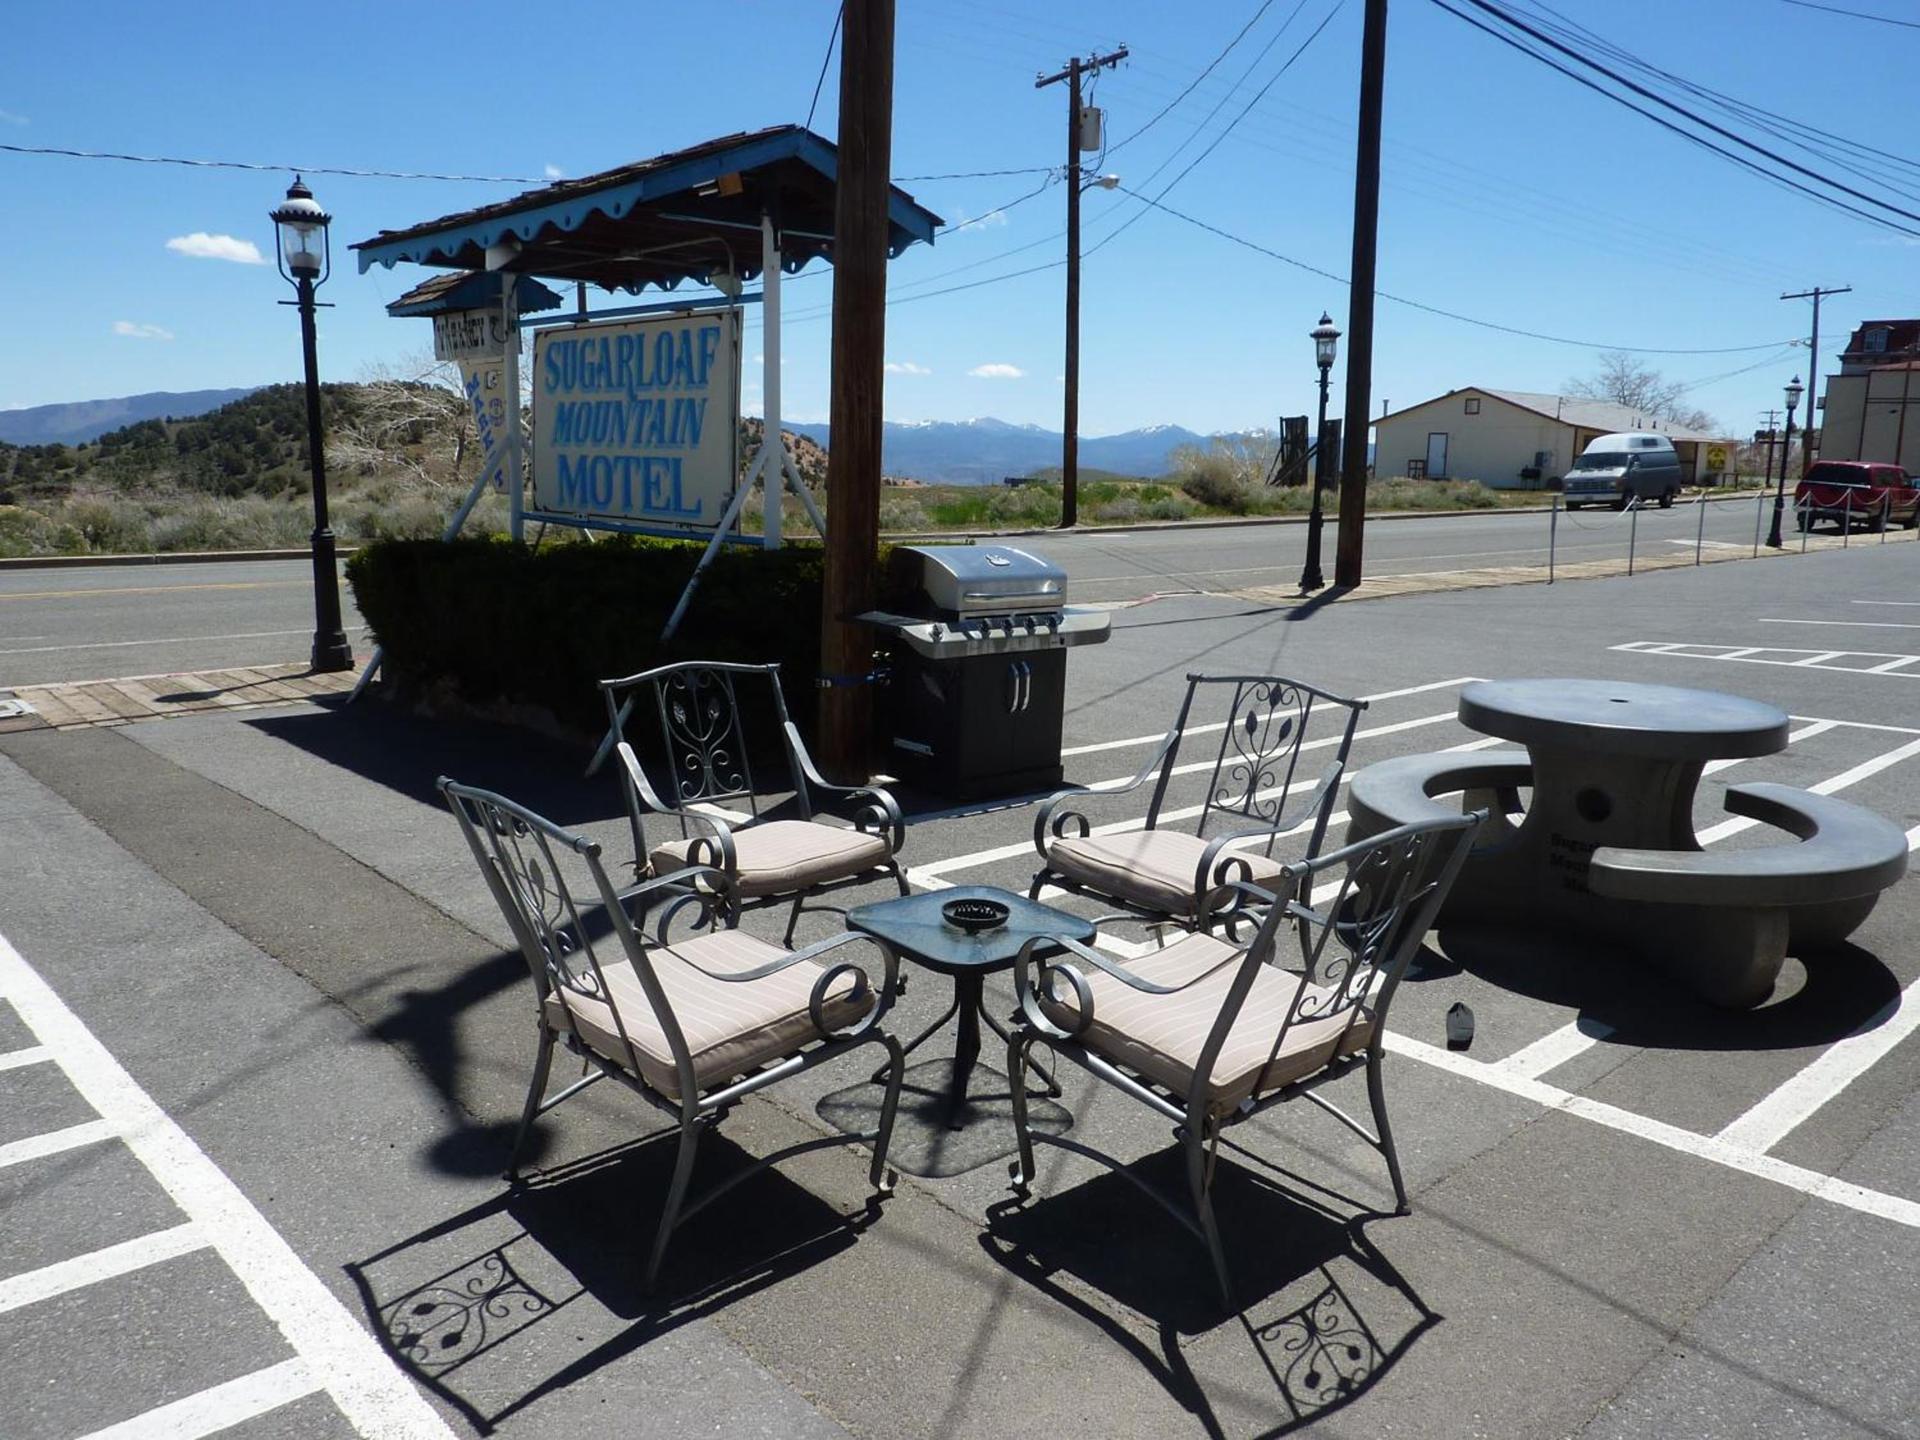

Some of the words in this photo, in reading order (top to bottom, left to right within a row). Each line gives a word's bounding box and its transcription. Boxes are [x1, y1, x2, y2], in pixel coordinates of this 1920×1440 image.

[544, 326, 721, 398] SUGARLOAF
[553, 398, 708, 448] MOUNTAIN
[557, 454, 703, 516] MOTEL
